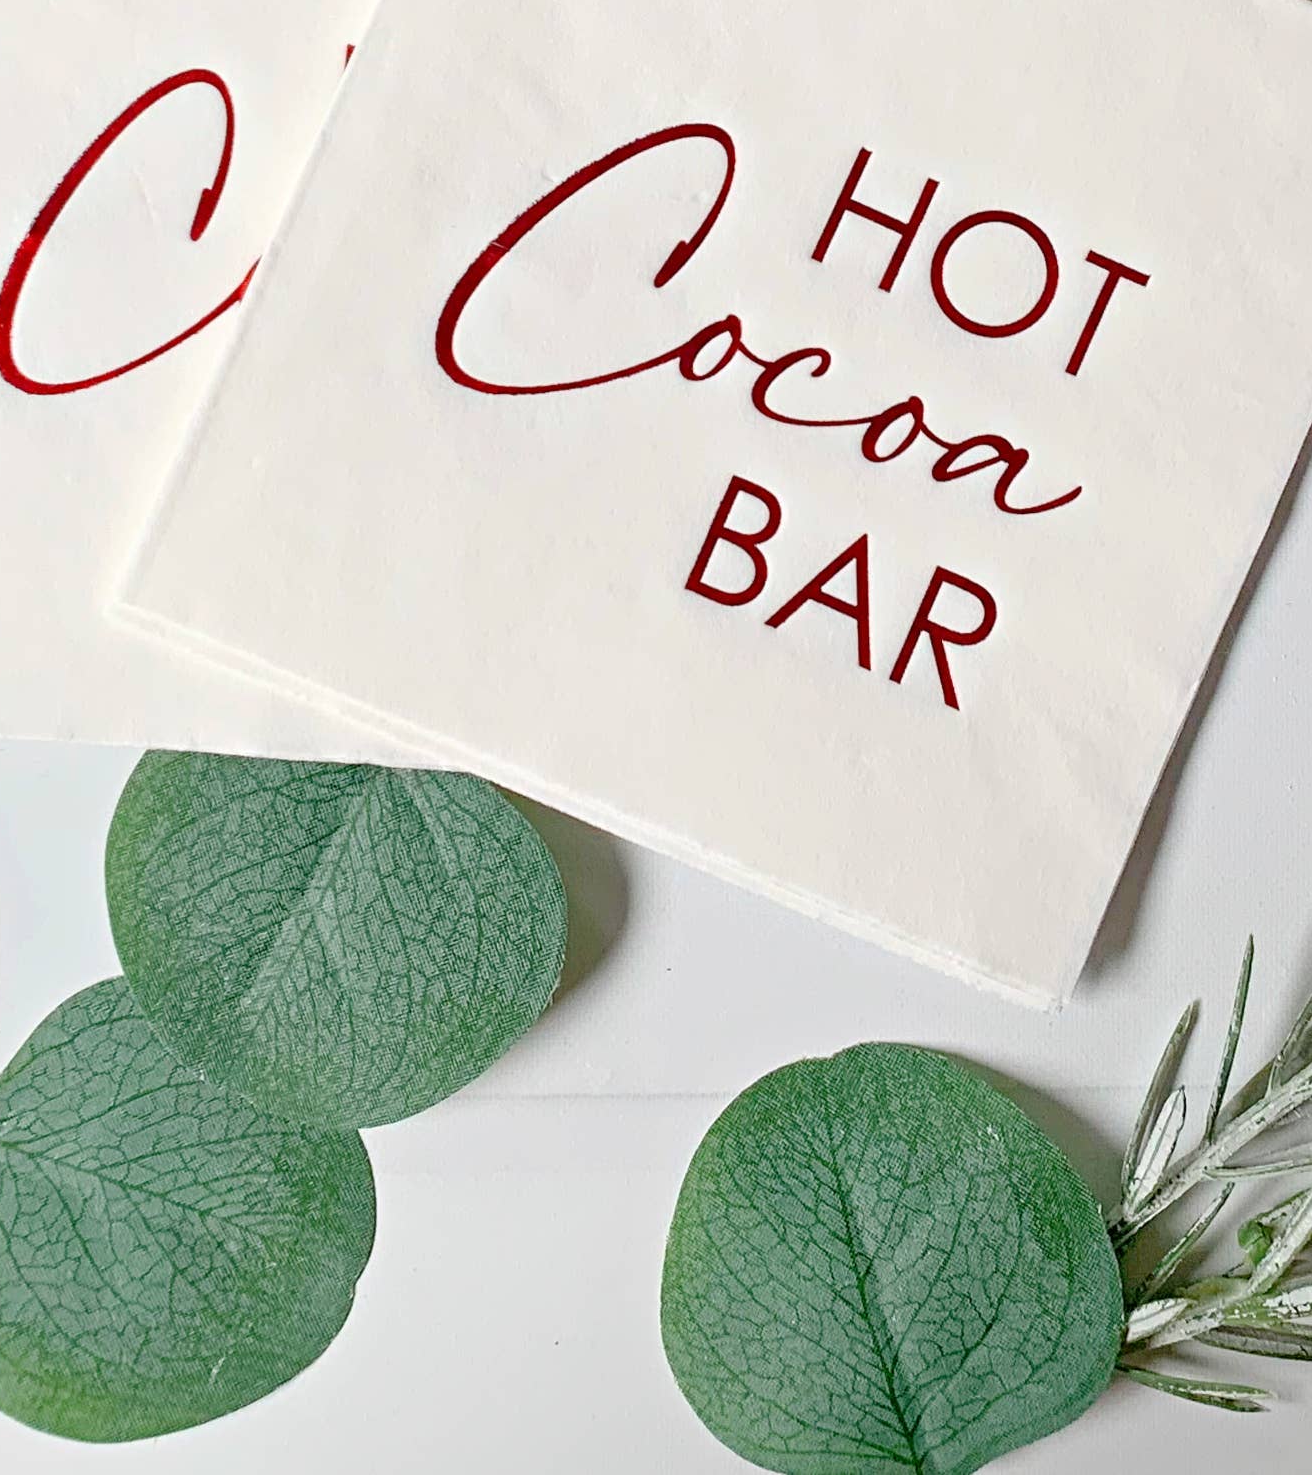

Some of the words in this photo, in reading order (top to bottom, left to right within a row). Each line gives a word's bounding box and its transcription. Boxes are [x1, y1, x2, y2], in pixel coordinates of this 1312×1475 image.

[434, 122, 1083, 515] Cocoa
[811, 147, 1150, 376] HOT
[684, 475, 998, 710] BAR
